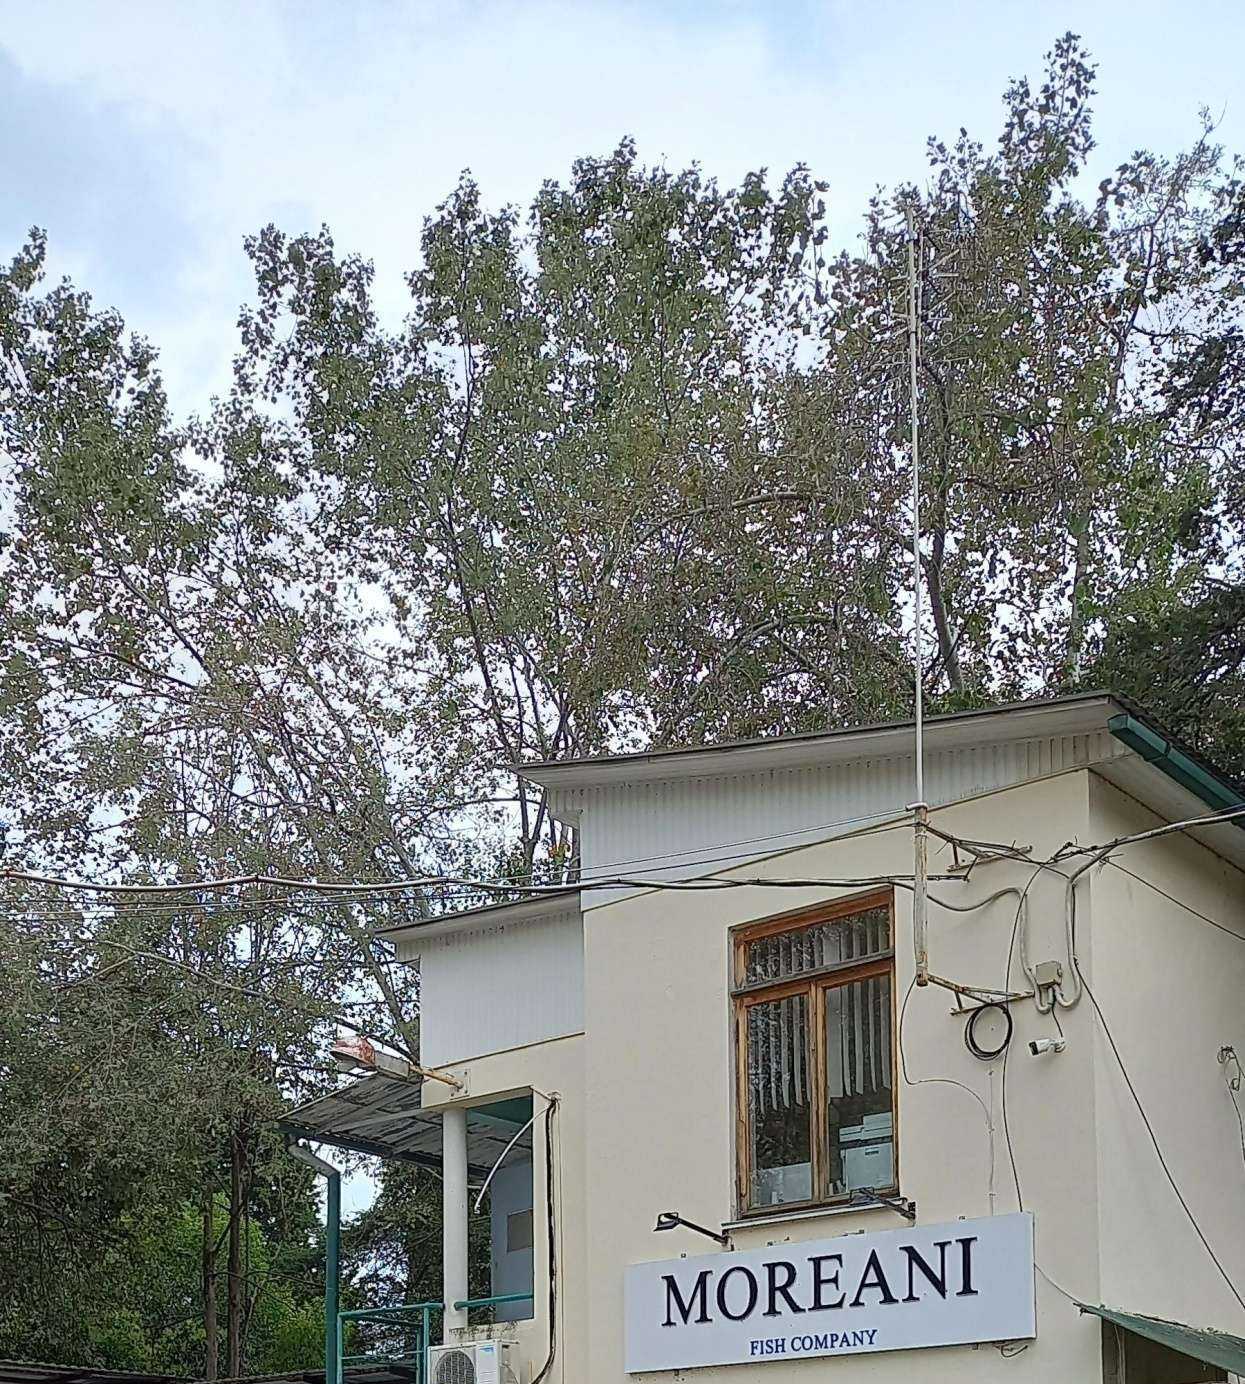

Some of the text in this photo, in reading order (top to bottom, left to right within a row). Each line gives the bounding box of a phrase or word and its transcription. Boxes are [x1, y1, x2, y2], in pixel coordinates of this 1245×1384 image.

[661, 1236, 979, 1327] MOREANI
[750, 1328, 879, 1356] FISH COMPANY
